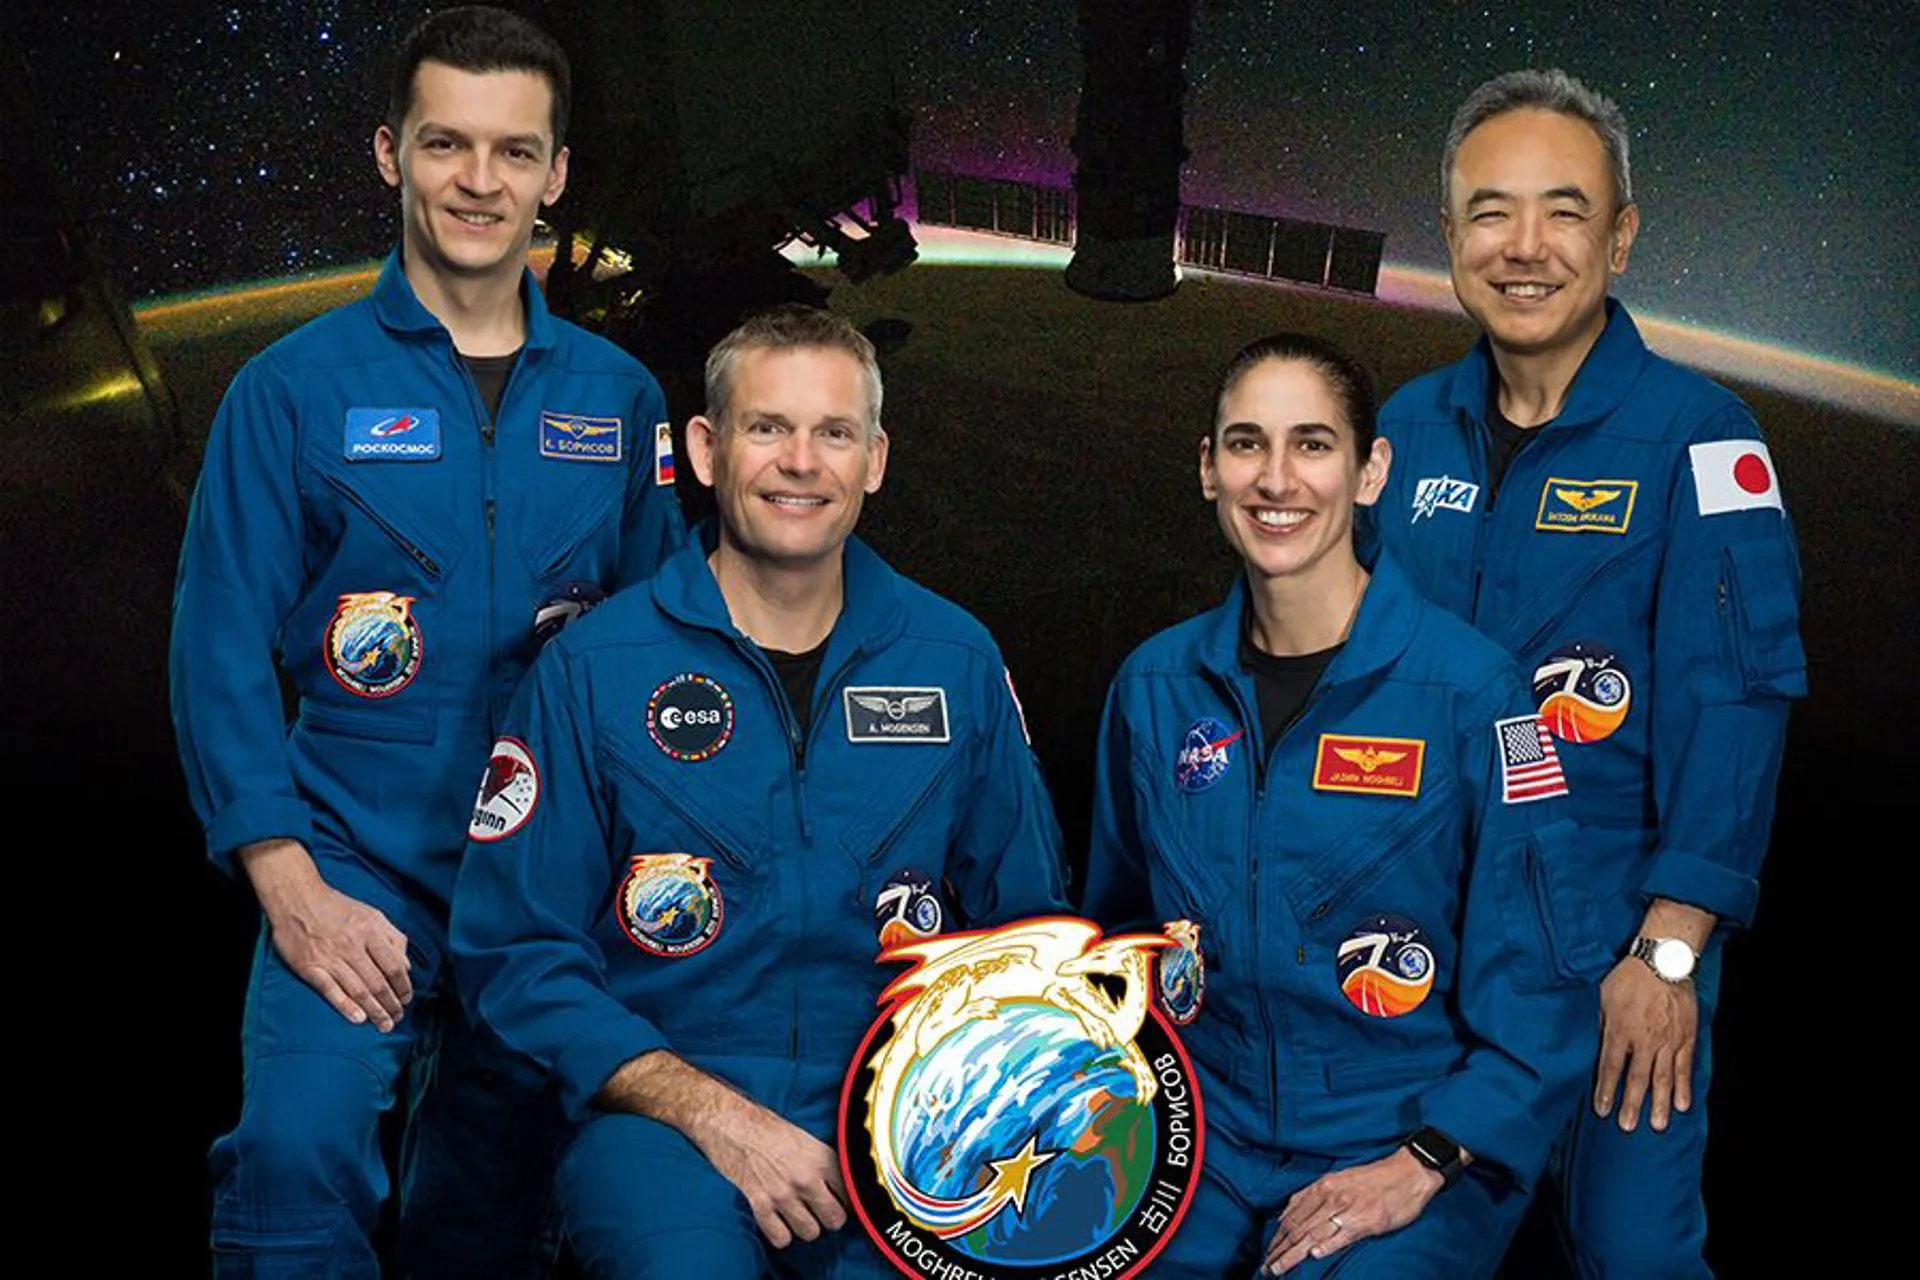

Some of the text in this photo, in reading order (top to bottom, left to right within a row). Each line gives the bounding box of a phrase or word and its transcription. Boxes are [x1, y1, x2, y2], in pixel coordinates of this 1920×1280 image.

[351, 443, 435, 455] РОСКОСМОС
[683, 709, 720, 725] esa
[1178, 744, 1229, 765] NASA
